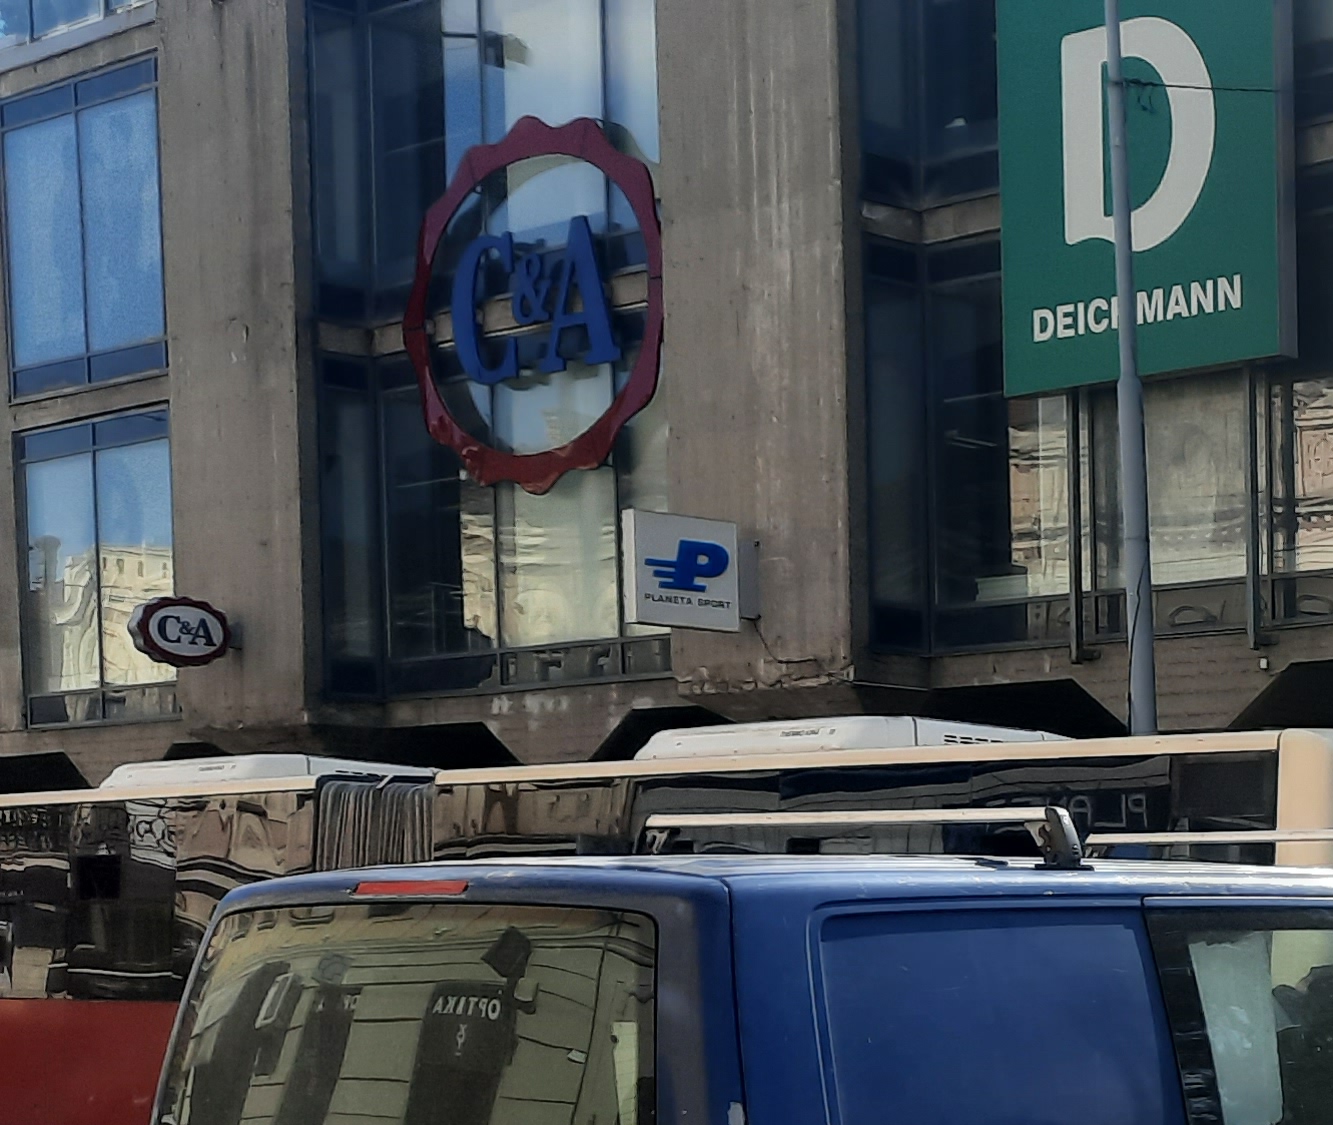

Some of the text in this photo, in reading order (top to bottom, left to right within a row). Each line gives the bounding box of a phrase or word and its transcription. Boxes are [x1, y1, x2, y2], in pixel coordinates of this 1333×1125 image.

[1061, 16, 1216, 252] D
[451, 215, 621, 385] C&A
[157, 614, 217, 647] C&A
[644, 592, 731, 609] PLANETA SPORT
